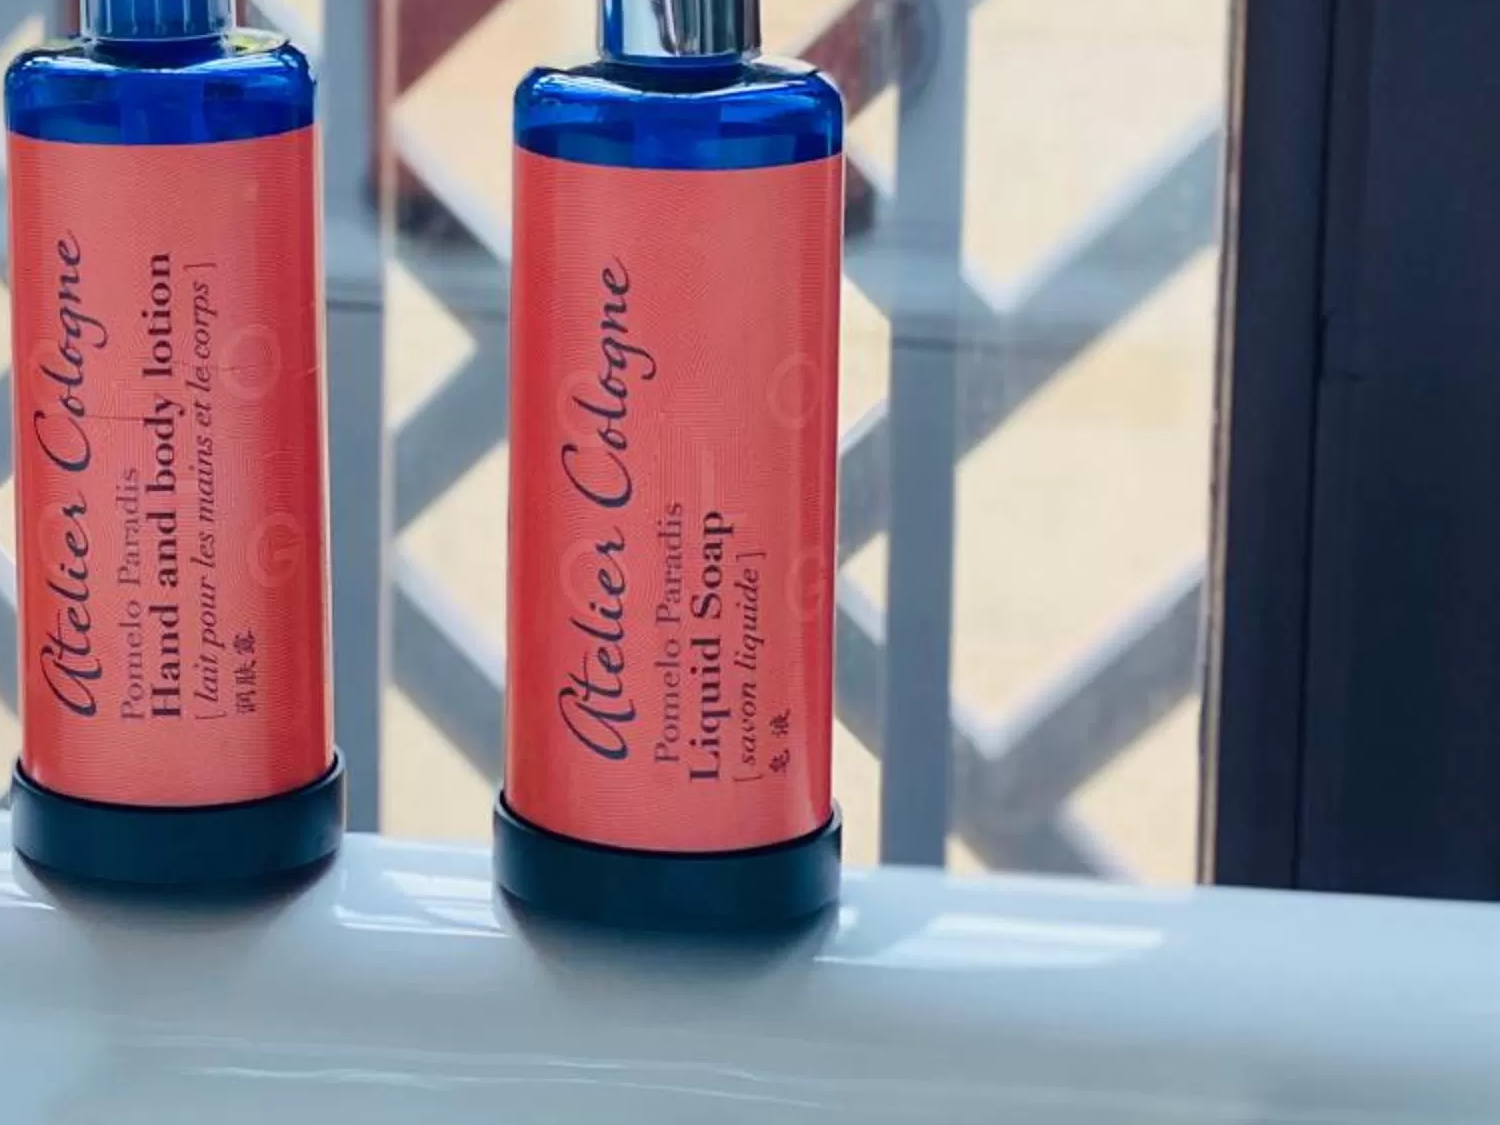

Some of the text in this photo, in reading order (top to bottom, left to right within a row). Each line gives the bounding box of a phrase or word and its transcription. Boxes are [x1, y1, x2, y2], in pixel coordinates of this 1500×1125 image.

[33, 229, 109, 717] Atelier Cologne
[141, 252, 185, 718] Hand and body lotion
[185, 366, 212, 393] le
[188, 434, 216, 524] mains
[194, 400, 213, 428] et
[116, 467, 145, 721] Pomelo Paradis
[190, 531, 218, 570] les
[199, 576, 226, 650] pour
[558, 254, 657, 760] Atelier Cologne
[654, 502, 683, 763] Pomelo Paradis
[689, 510, 734, 784] Liquid Soap
